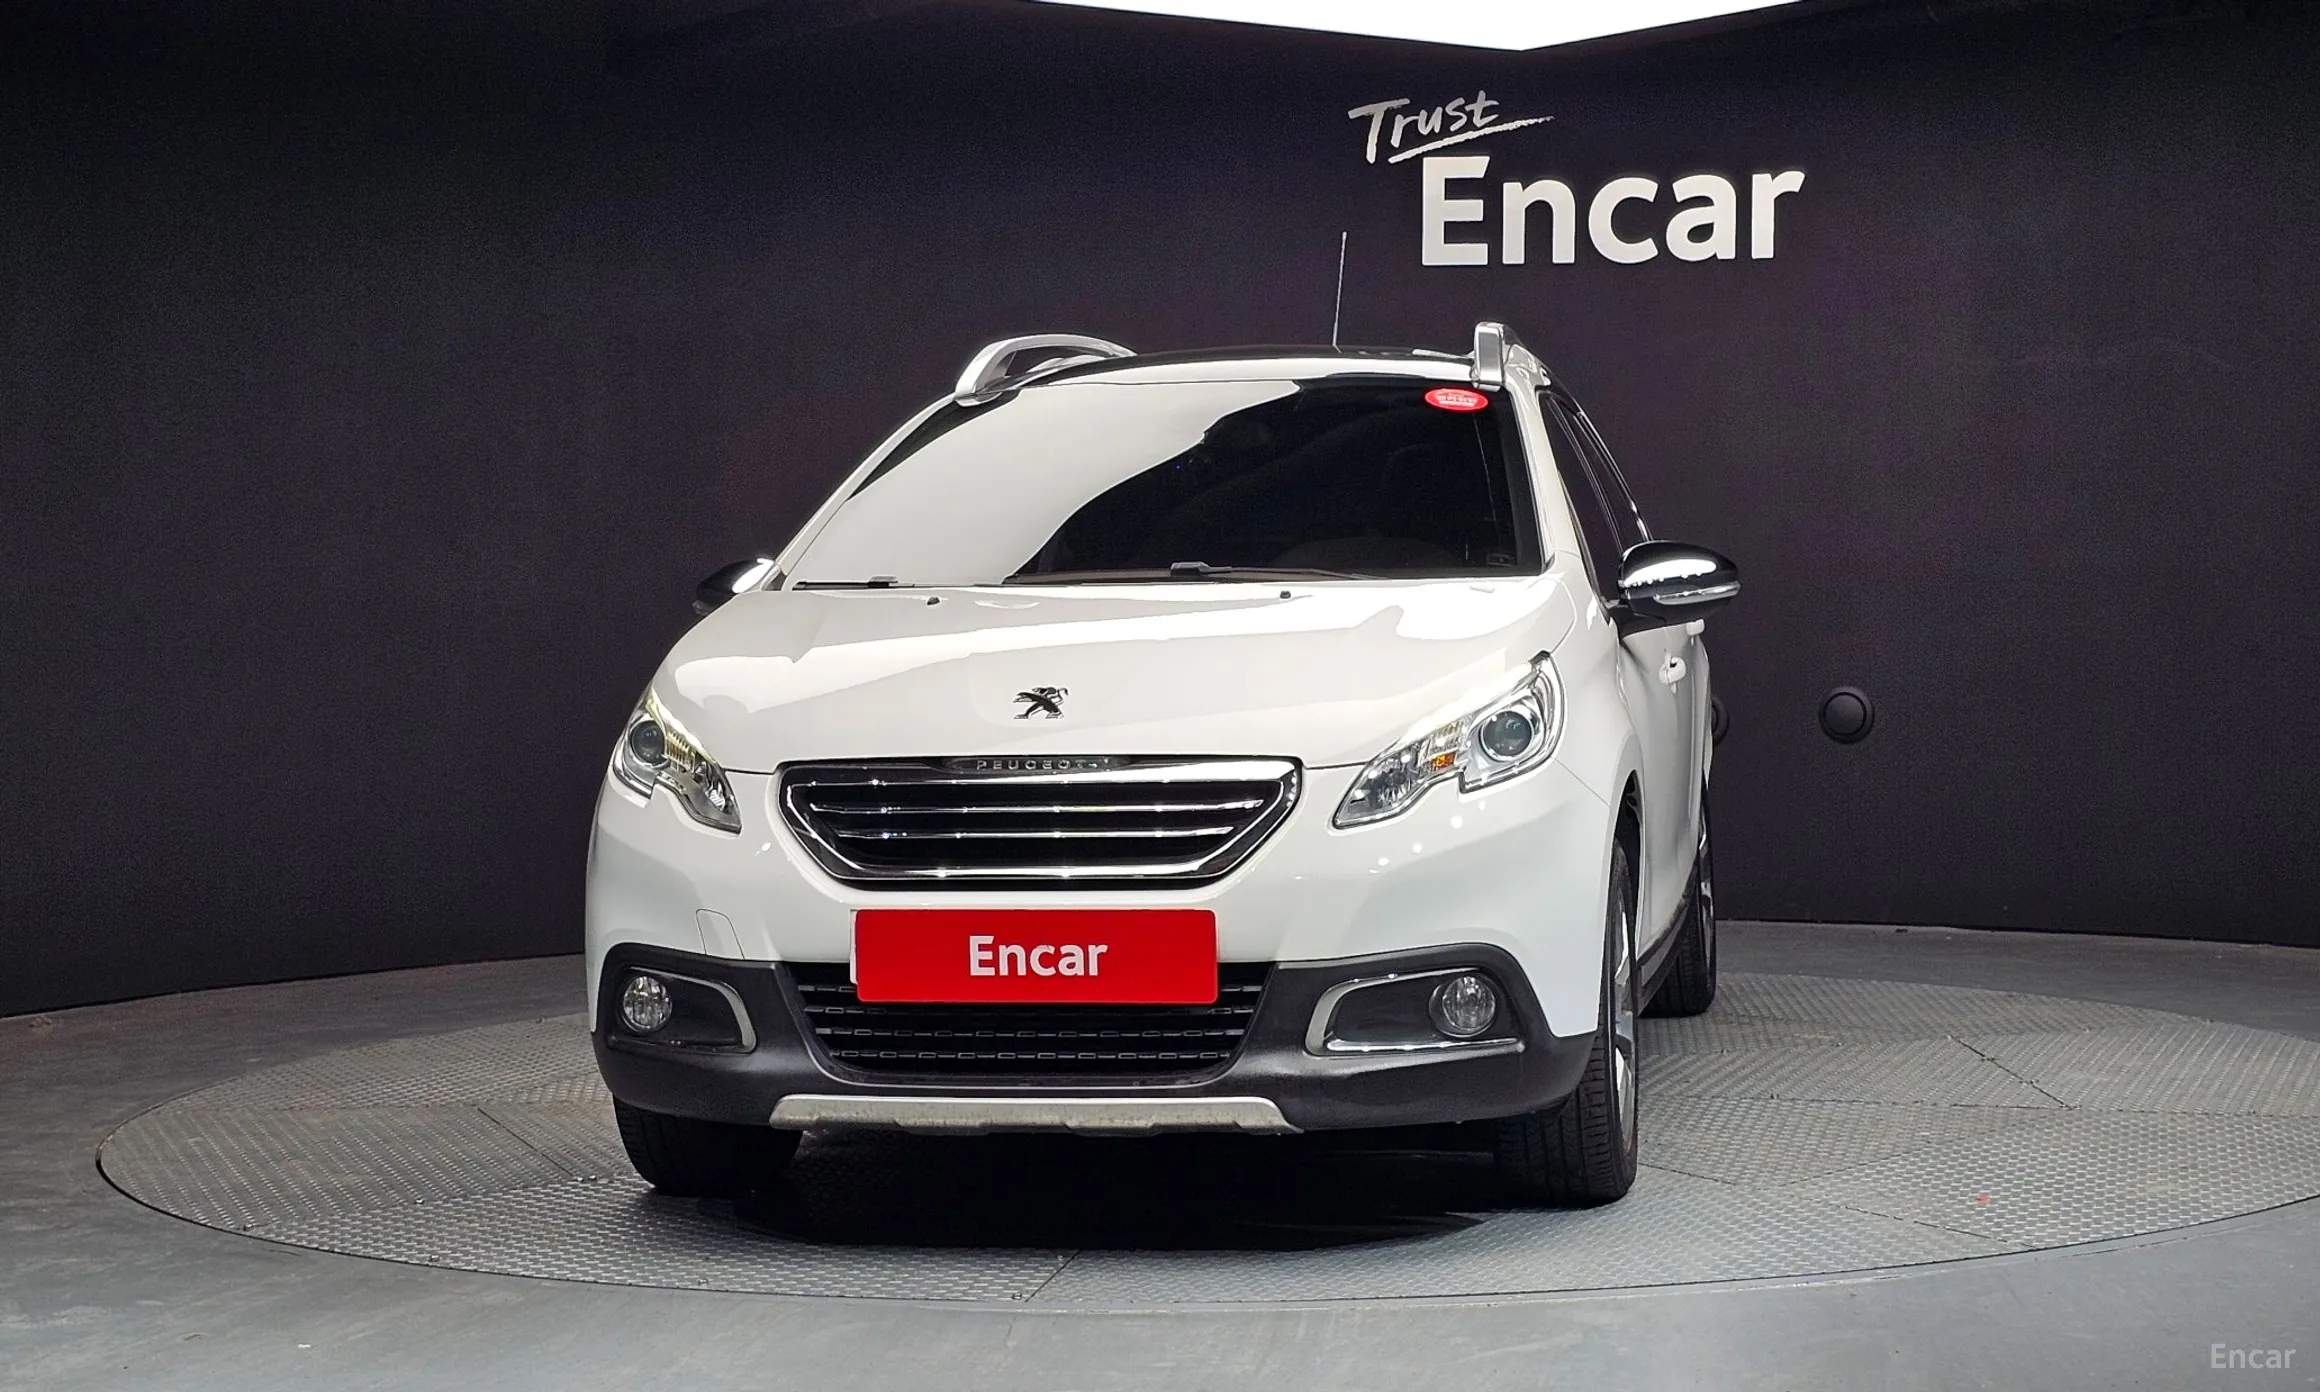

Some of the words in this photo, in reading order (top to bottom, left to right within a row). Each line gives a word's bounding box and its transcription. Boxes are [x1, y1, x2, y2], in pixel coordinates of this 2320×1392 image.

[1348, 90, 1501, 164] Trust
[1421, 155, 1806, 266] Encar
[969, 935, 1108, 976] Encar
